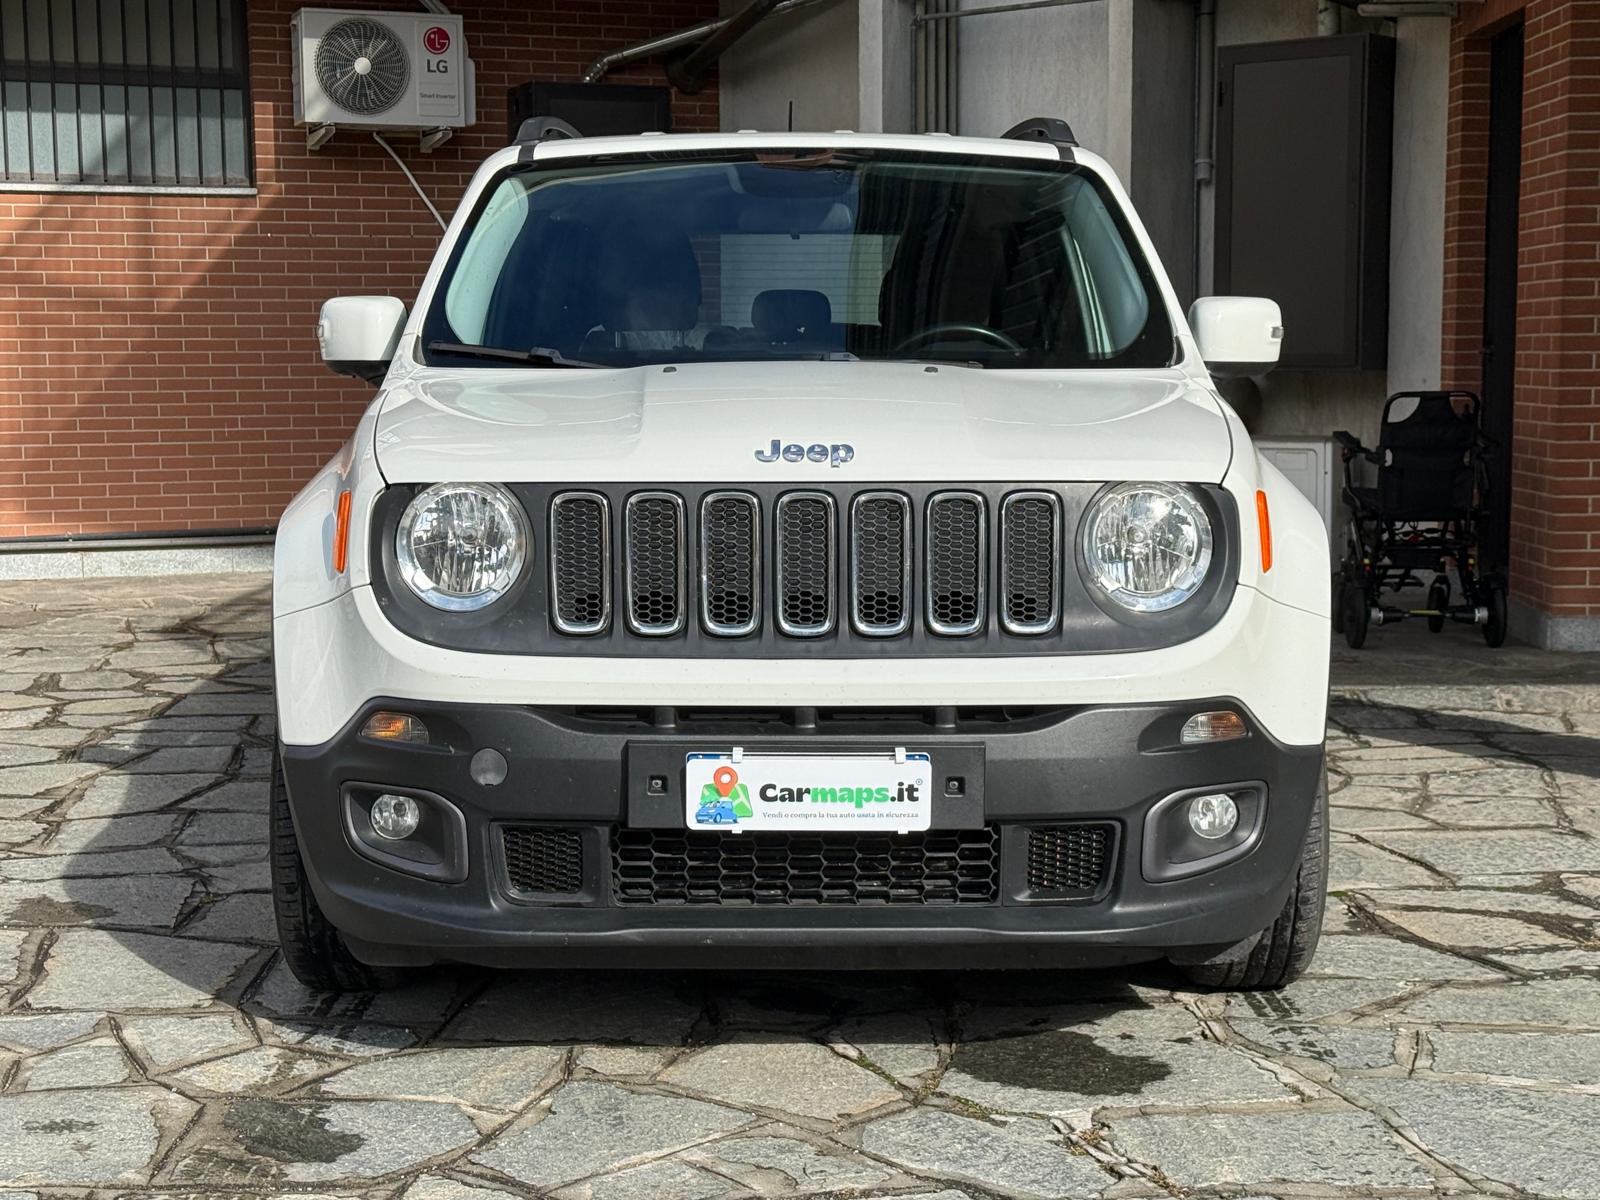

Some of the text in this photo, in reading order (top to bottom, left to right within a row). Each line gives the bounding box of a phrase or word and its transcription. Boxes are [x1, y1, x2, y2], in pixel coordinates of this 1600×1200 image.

[427, 59, 448, 73] LG
[754, 439, 855, 468] Jeep
[759, 781, 919, 808] Carmaps.it
[790, 812, 817, 820] compra
[877, 810, 884, 818] in
[885, 810, 919, 818] sicurezza
